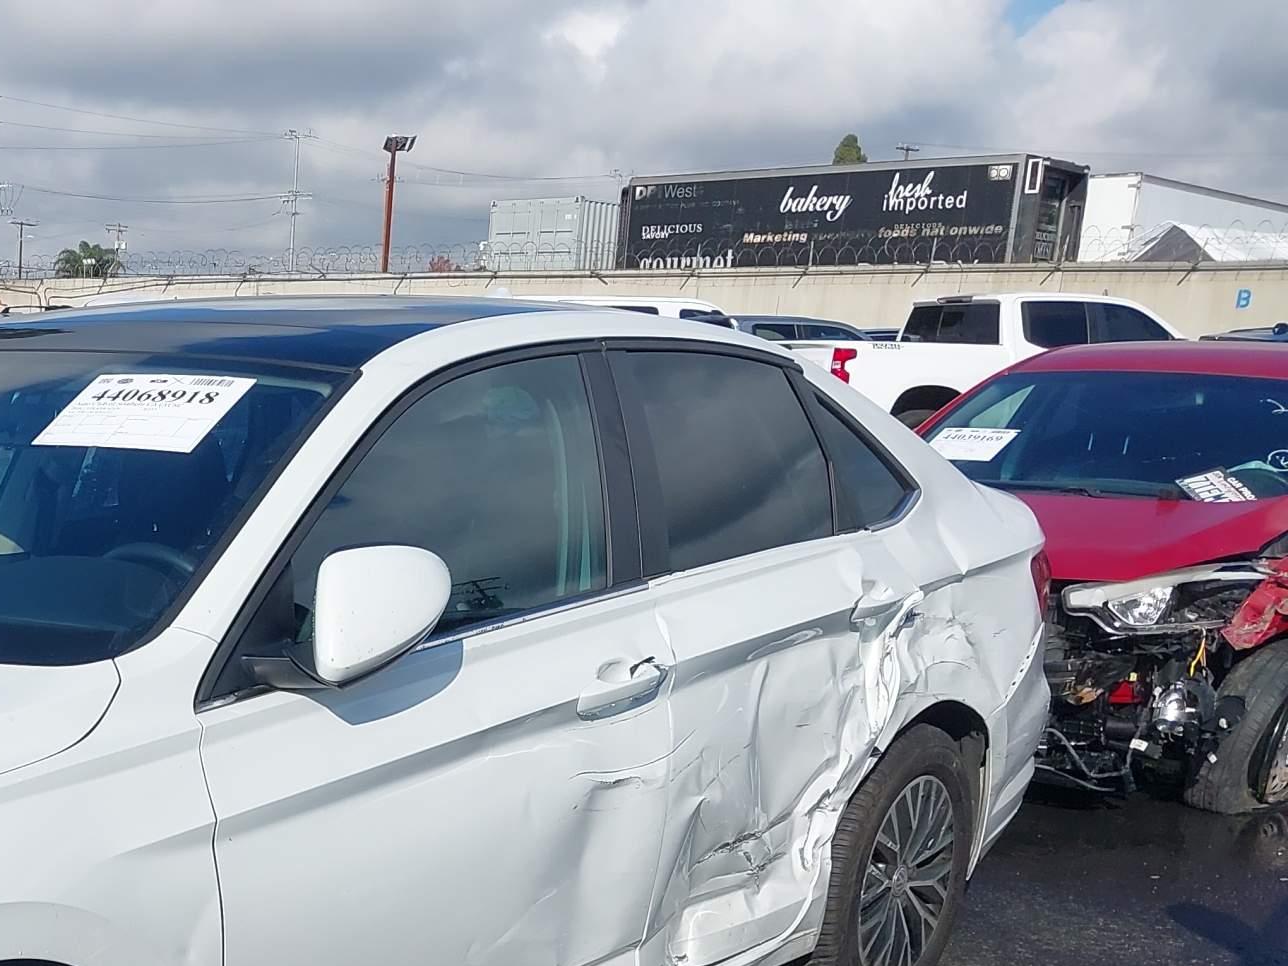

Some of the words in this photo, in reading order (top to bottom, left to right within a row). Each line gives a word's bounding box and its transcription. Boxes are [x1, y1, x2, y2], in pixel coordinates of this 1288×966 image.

[664, 184, 698, 199] West
[888, 170, 936, 200] fresh
[779, 185, 853, 222] bakery
[882, 190, 967, 214] imported
[641, 223, 703, 235] DELICIOUS
[742, 231, 808, 244] Marketing
[1235, 288, 1252, 309] B
[90, 388, 221, 405] 44068918
